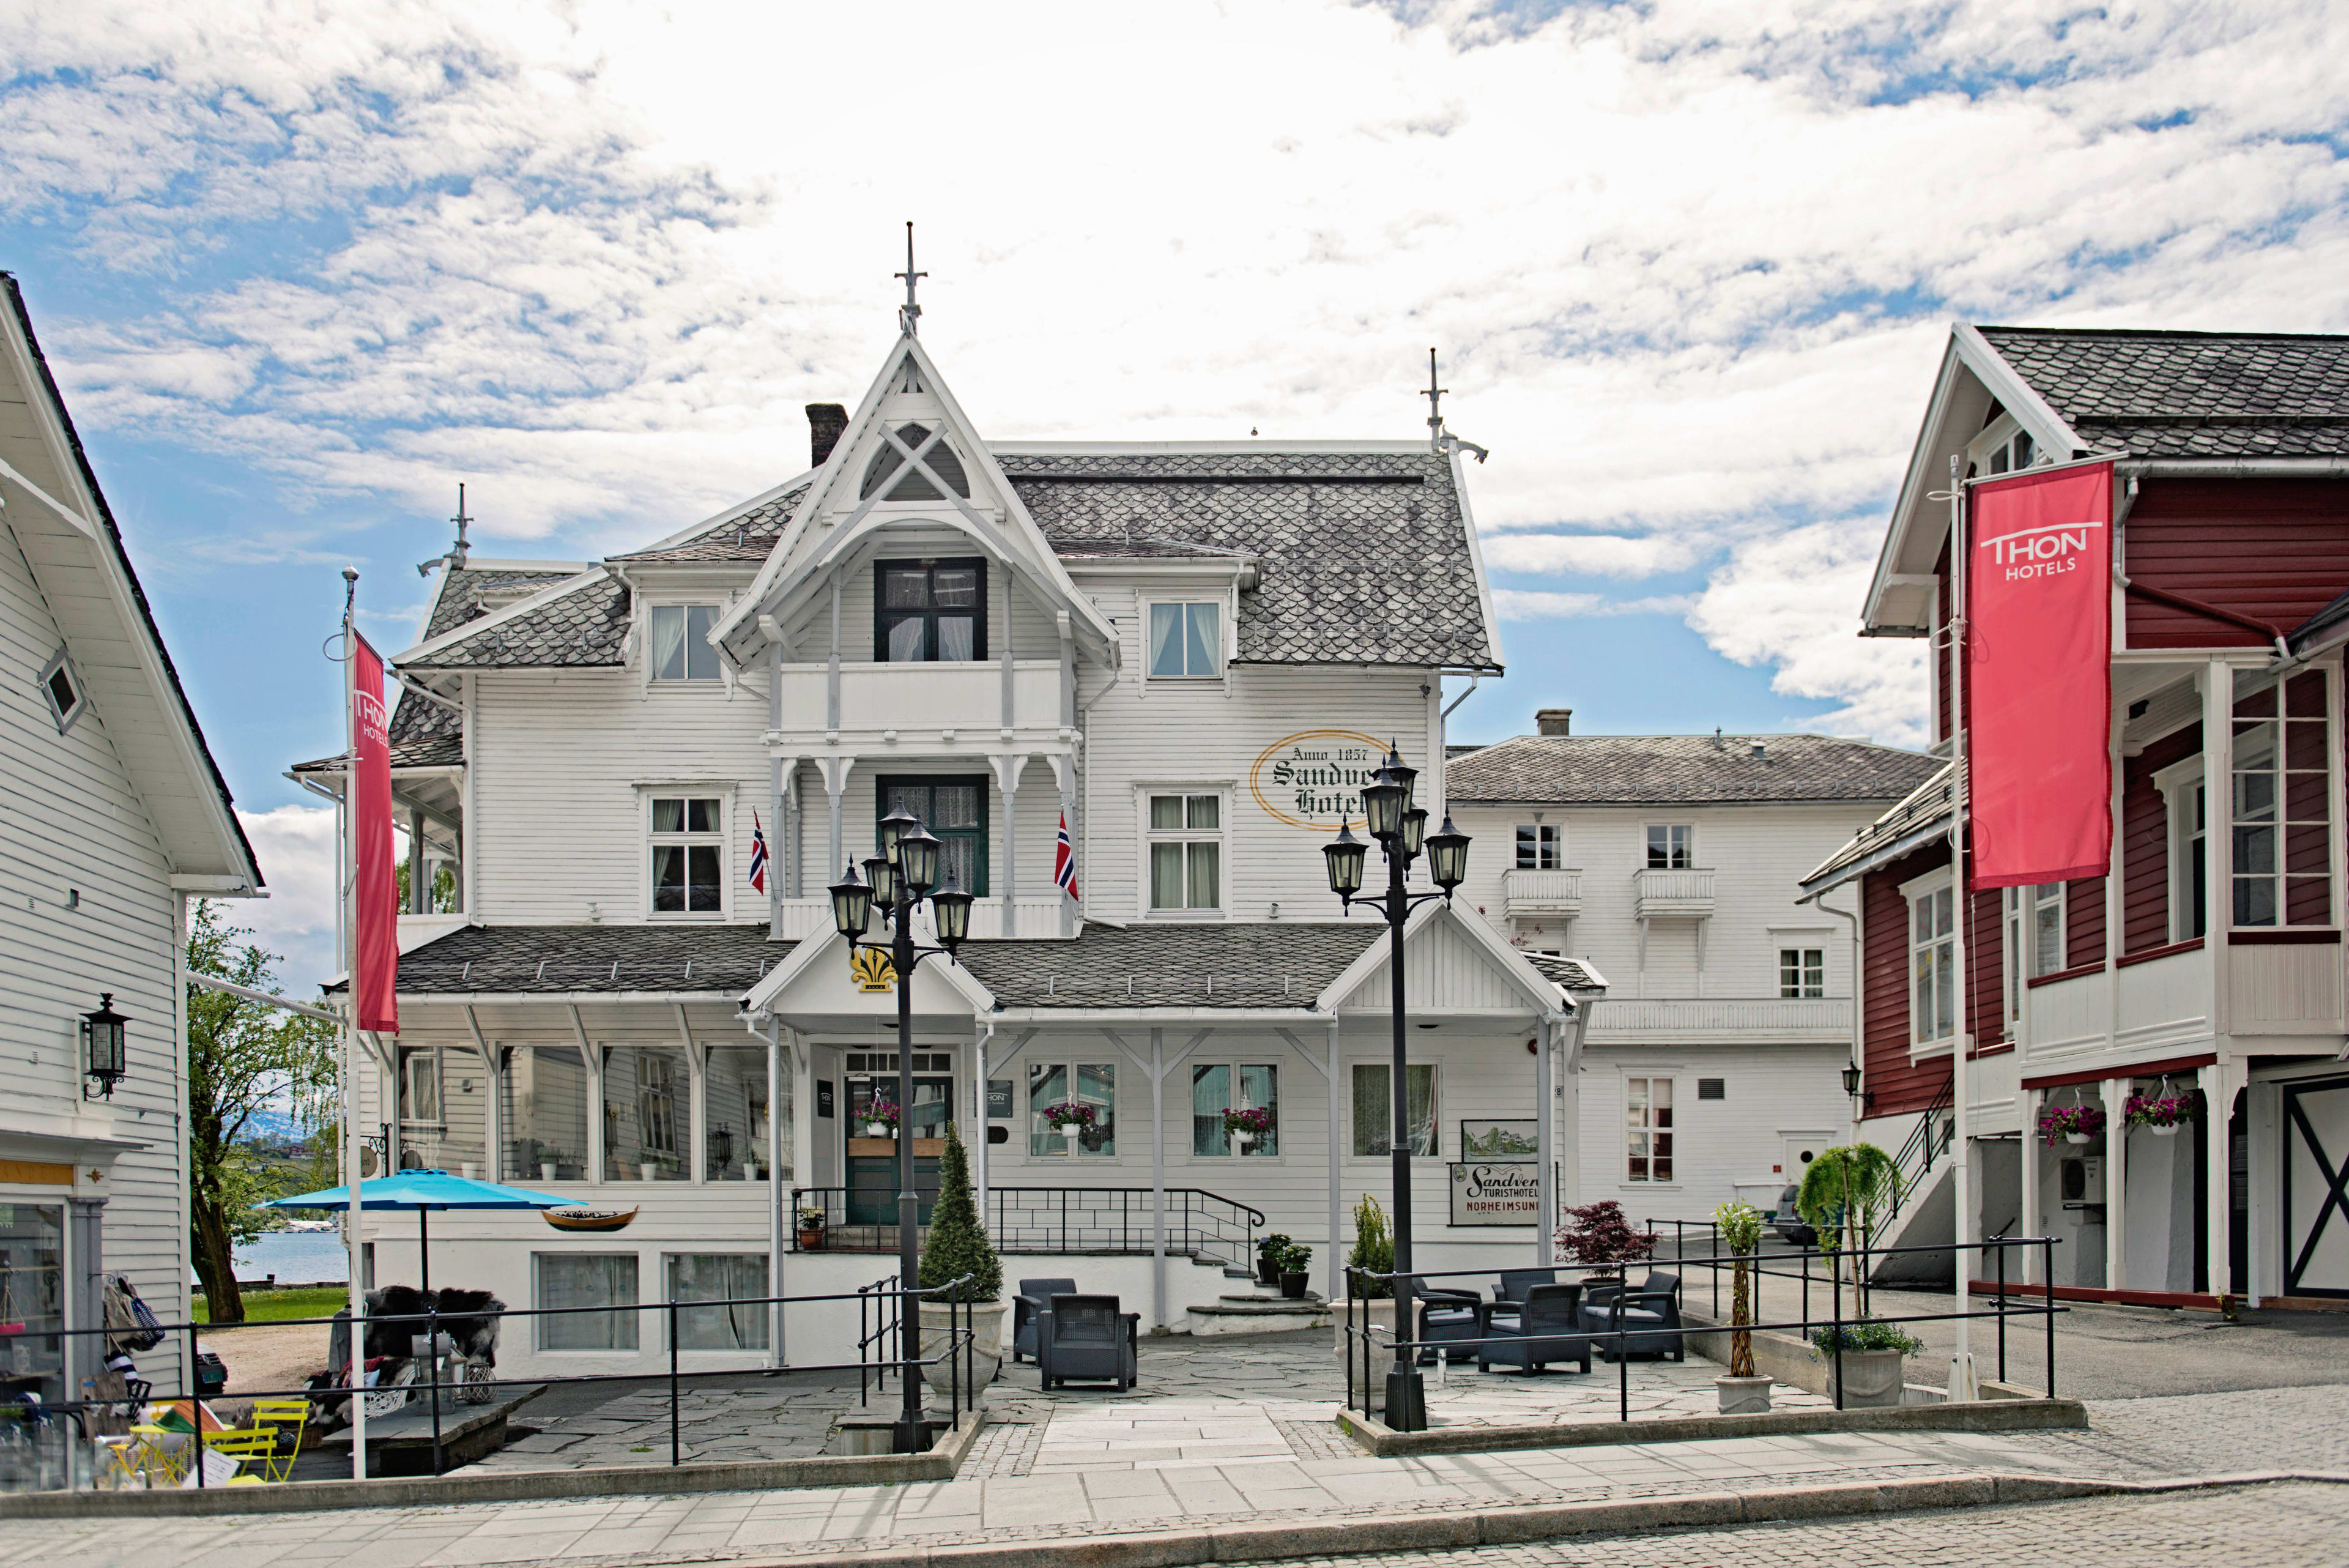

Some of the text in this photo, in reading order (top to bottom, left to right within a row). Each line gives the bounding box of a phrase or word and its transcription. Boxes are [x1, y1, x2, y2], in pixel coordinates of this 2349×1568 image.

[1980, 522, 2103, 564] THON
[2006, 557, 2076, 581] HOTELS
[354, 689, 388, 735] THON
[363, 723, 388, 748] HOTELS
[1291, 748, 1368, 760] Anno 1857
[1272, 760, 1372, 787] Sandve
[1295, 789, 1367, 820] Hotel
[820, 1093, 832, 1101] THON
[1466, 1166, 1538, 1198] Sandven
[1483, 1188, 1538, 1197] TURISTHOTEL
